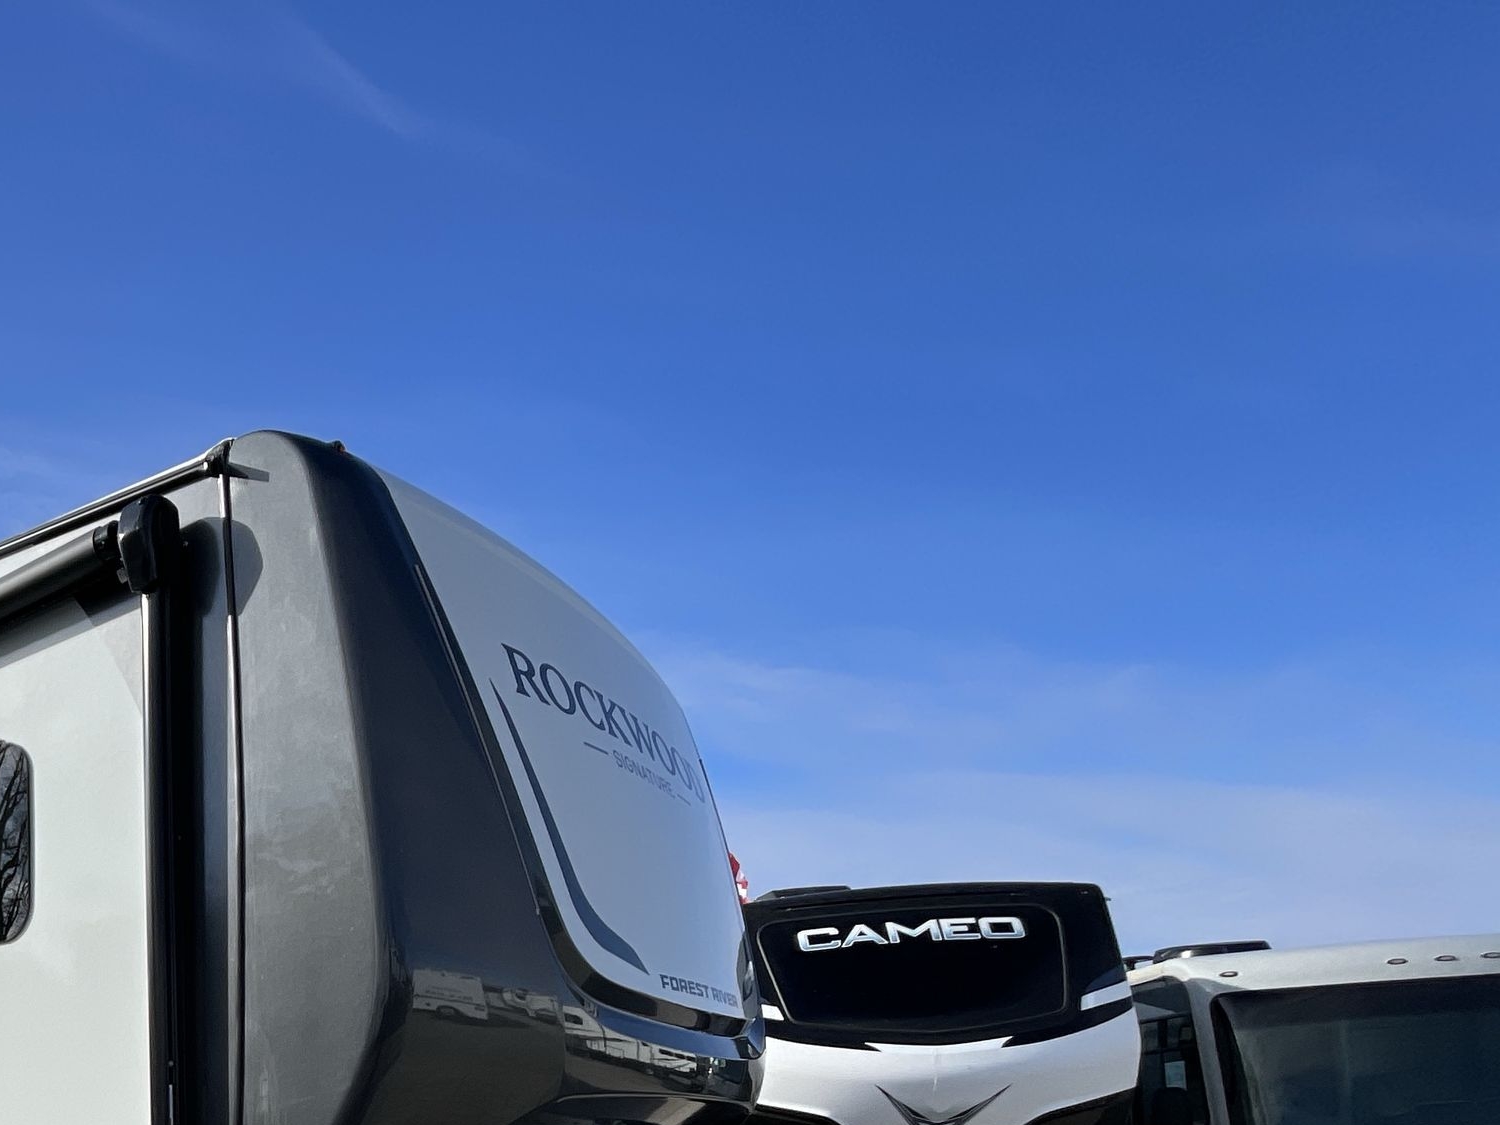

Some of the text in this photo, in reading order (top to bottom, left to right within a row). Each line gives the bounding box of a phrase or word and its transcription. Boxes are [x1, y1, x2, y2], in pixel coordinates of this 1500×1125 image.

[501, 643, 705, 803] ROCKWOOD
[796, 916, 1026, 952] CAMEO
[659, 974, 739, 1008] FOREST RIVER
